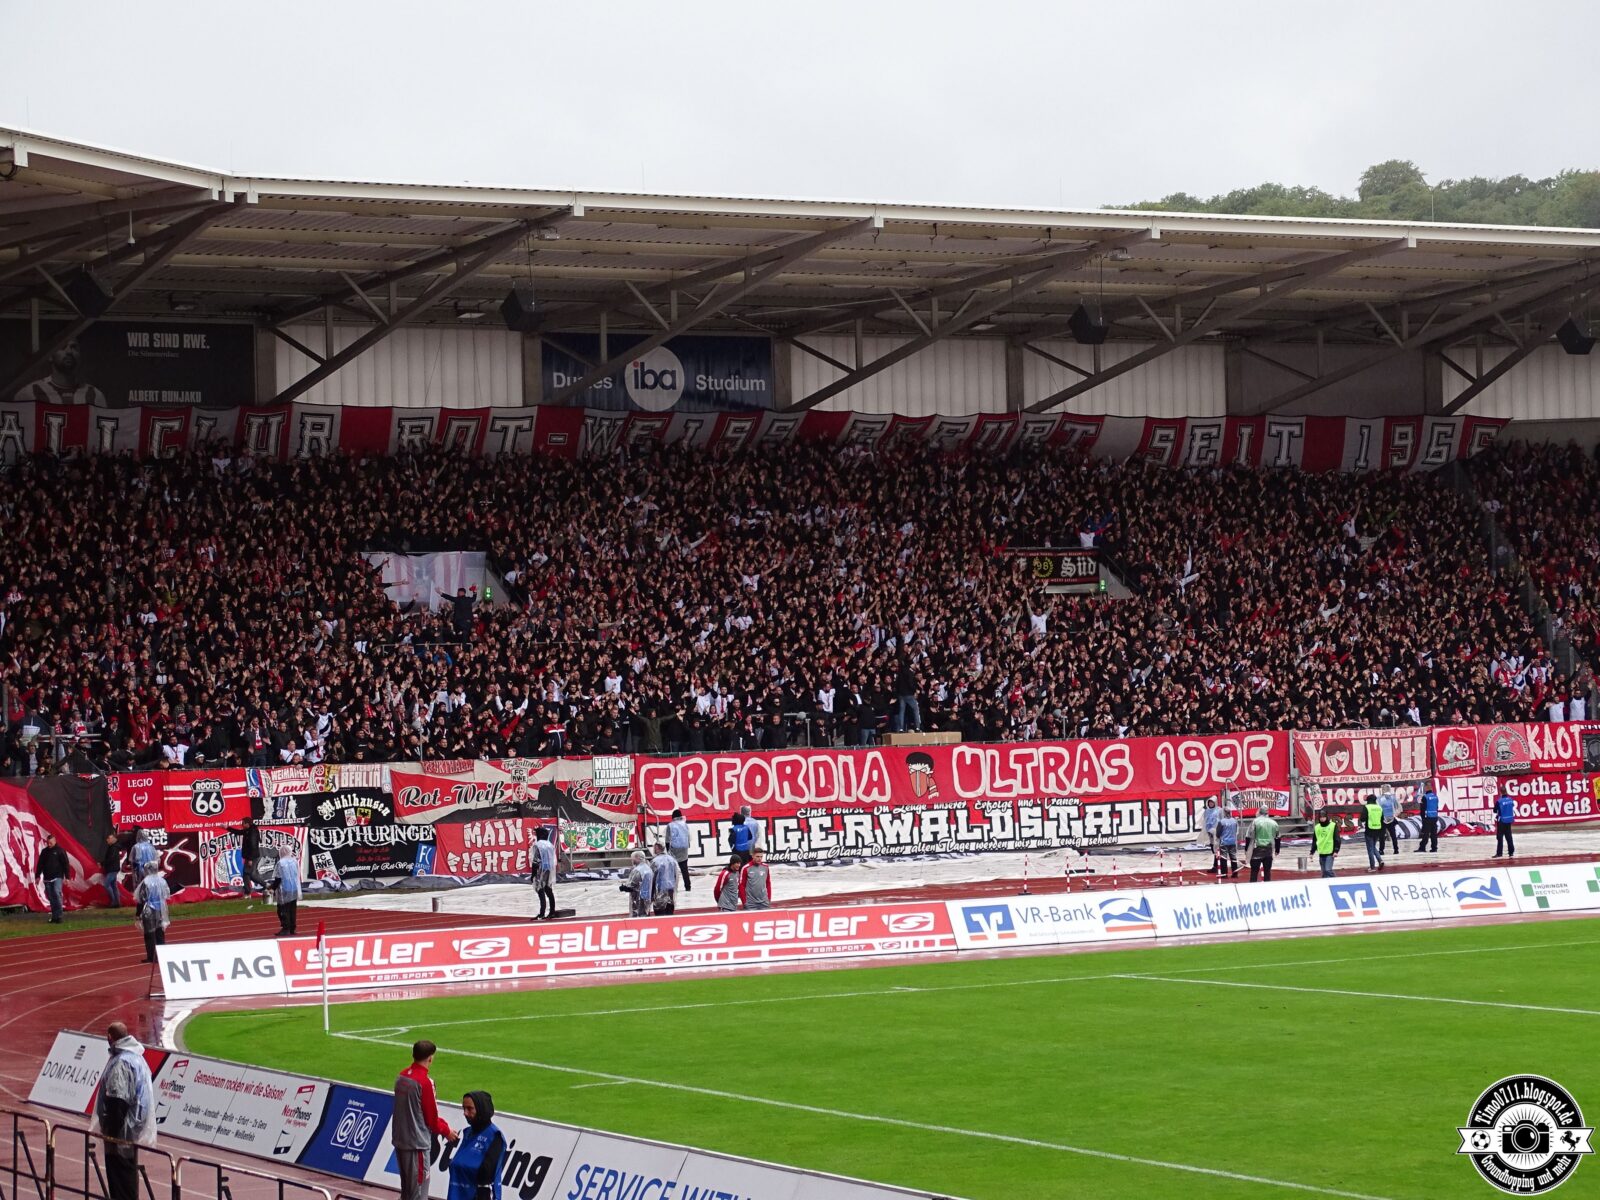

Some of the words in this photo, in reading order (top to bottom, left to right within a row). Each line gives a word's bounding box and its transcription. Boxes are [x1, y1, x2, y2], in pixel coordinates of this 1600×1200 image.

[127, 332, 150, 349] WIR
[153, 332, 179, 349] SIND
[183, 333, 211, 350] RWE.
[633, 360, 677, 391] iba
[696, 374, 766, 391] Studium
[129, 390, 159, 402] ALBERT
[161, 390, 202, 403] BUNJAKU
[1147, 421, 1304, 469] SEIT
[127, 777, 154, 788] LEGIO
[195, 781, 221, 791] ROOTS
[341, 772, 381, 787] BERLIN
[640, 751, 892, 816] ERFORDIA
[953, 743, 1134, 799] ULTRAS
[1157, 735, 1275, 786] 1996
[1505, 776, 1562, 797] Gotha
[1566, 773, 1590, 794] ist
[274, 781, 310, 795] Land
[400, 786, 440, 808] Rot
[451, 781, 505, 806] Weiß
[571, 779, 633, 807] Erfurt
[1326, 788, 1355, 805] LOS
[1434, 777, 1499, 811] WEST
[195, 792, 222, 814] 66
[316, 793, 391, 821] Mühlhausen
[797, 807, 827, 818] Einst
[1512, 795, 1592, 818] Rot-Weiß
[121, 812, 163, 824] ERFORDIA
[463, 819, 524, 849] MAIN
[315, 853, 325, 861] FC
[767, 847, 790, 861] nach
[798, 847, 819, 860] dem
[827, 844, 863, 859] Glanz
[868, 843, 904, 856] Deiner
[911, 842, 936, 854] alten
[938, 837, 969, 852] Tage
[976, 838, 1008, 850] werden
[1014, 838, 1031, 849] wir
[1037, 837, 1053, 848] uns
[1060, 835, 1081, 848] ewig
[1088, 832, 1119, 846] sehnen
[314, 859, 334, 870] RWE
[447, 849, 535, 873] FIGHTE
[1377, 881, 1452, 903] VR-Bank
[1016, 904, 1097, 925] VR-Bank
[1173, 908, 1203, 931] Wir
[1206, 900, 1278, 926] kümmern
[1281, 886, 1313, 909] uns!
[166, 955, 277, 984] NT.AG
[42, 1061, 100, 1087] DOMPALAIS
[193, 1070, 226, 1088] Gemeinsam
[223, 1076, 244, 1092] rocken
[244, 1081, 255, 1095] wir
[253, 1082, 265, 1096] die
[262, 1084, 287, 1101] Saison!
[281, 1104, 313, 1121] NextPhones
